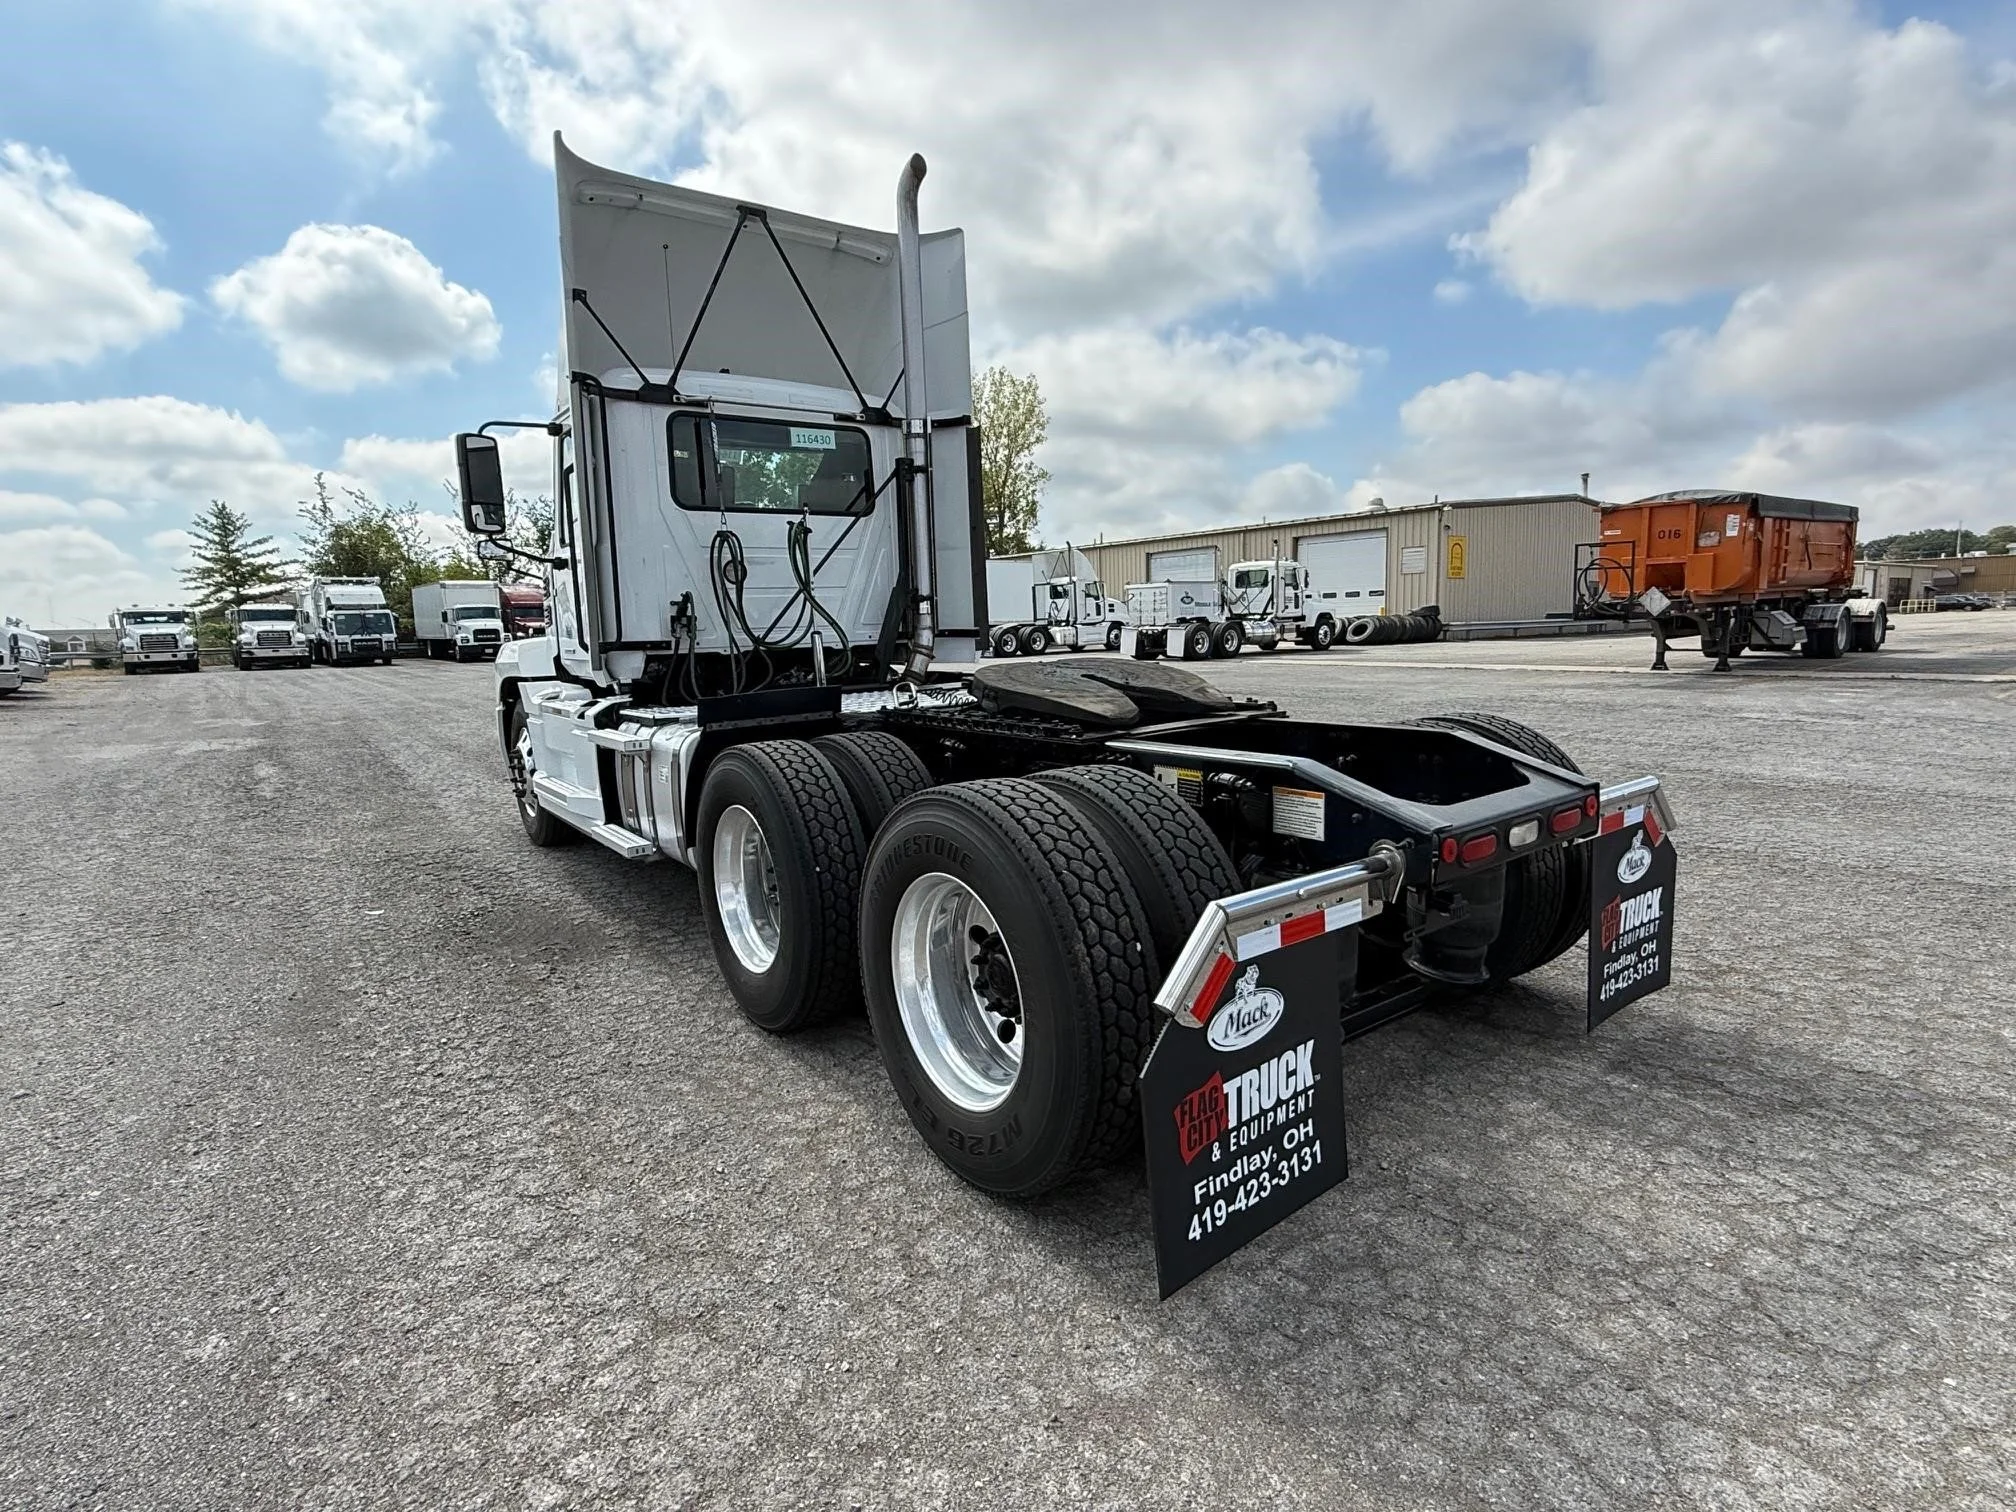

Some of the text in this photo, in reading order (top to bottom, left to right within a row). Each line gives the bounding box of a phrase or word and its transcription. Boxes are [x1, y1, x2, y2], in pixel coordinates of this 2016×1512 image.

[796, 434, 831, 445] 116430
[1658, 529, 1682, 541] 016
[1623, 854, 1646, 876] Mack
[1619, 886, 1663, 934] TRUCK
[1618, 920, 1660, 950] EQUIPMENT
[1600, 955, 1659, 1002] 419-423-3131
[1603, 939, 1657, 980] Findlay, OH
[1223, 996, 1271, 1040] Mack
[1179, 1084, 1221, 1129] FLAG
[1222, 1038, 1315, 1130] TRUCK
[1187, 1107, 1226, 1152] CITY
[1211, 1089, 1316, 1163] & EQUIPMENT
[1193, 1117, 1315, 1206] Findlay, OH
[1187, 1139, 1323, 1243] 419-423-3131
